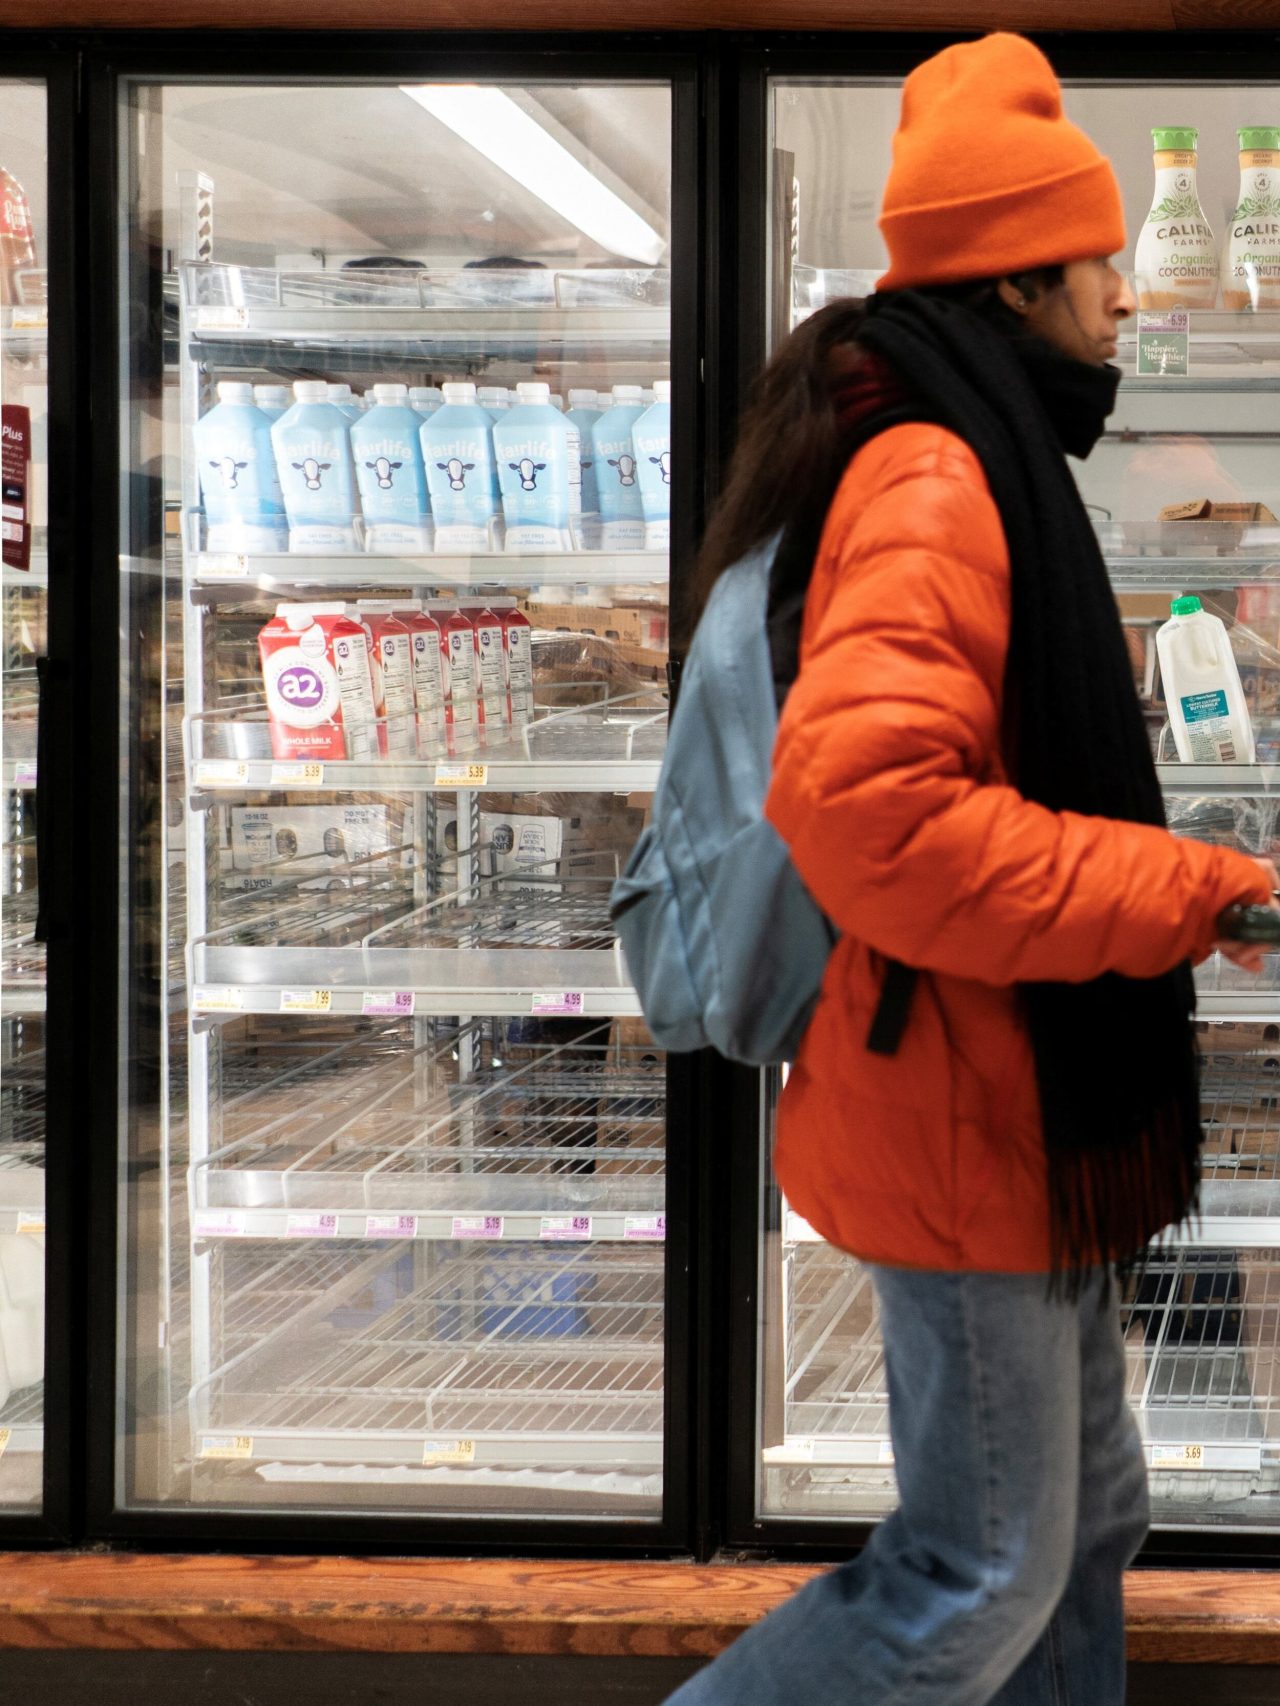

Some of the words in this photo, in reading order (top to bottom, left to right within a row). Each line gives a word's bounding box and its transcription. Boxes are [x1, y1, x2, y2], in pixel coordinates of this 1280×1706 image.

[1179, 179, 1187, 187] 4
[1258, 179, 1266, 187] 4
[1157, 224, 1214, 240] CALIFIA
[1170, 253, 1213, 266] Organic
[1171, 314, 1187, 326] 6.99
[2, 425, 24, 442] Plus
[496, 440, 559, 459] fairlife
[280, 673, 321, 700] a2
[311, 737, 332, 745] MILK
[304, 765, 320, 777] 5.39
[467, 765, 484, 777] 5.39
[315, 990, 330, 1005] 7.99
[395, 994, 413, 1007] 4.99
[564, 993, 582, 1005] 4.99
[319, 1216, 337, 1228] 4.99
[398, 1216, 415, 1229] 5.19
[484, 1217, 501, 1230] 5.19
[572, 1217, 590, 1230] 4.99
[236, 1437, 251, 1449] 7.19
[457, 1440, 472, 1452] 7.19
[1185, 1447, 1201, 1459] 5.69
